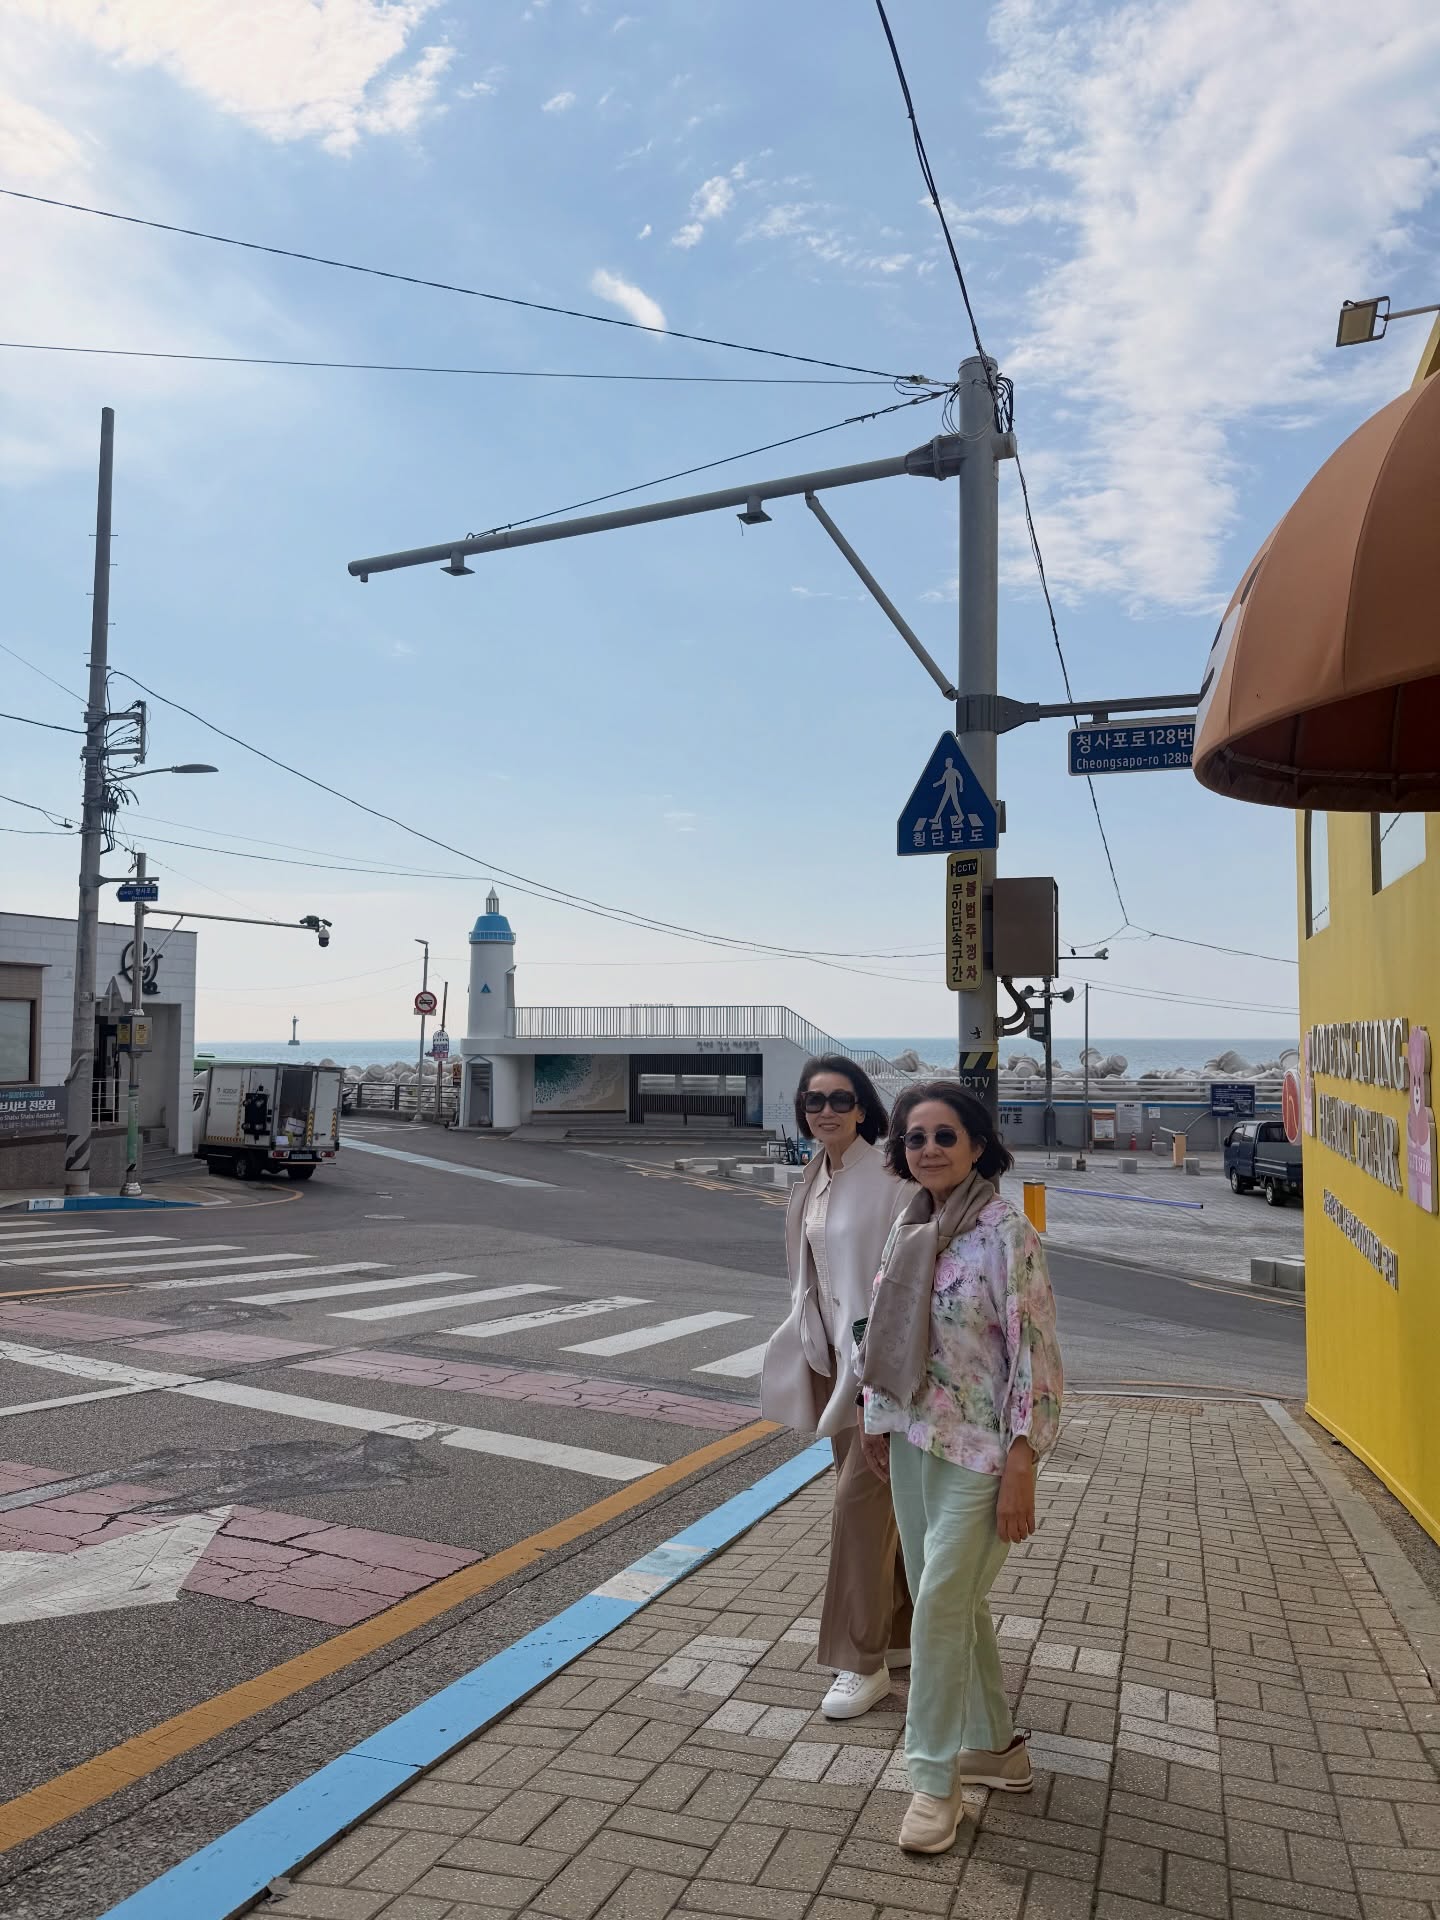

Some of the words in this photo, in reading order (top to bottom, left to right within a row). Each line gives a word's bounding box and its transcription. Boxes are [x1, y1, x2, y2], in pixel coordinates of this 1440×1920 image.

[1076, 755, 1158, 769] Cheongsapo-ro
[912, 829, 984, 847] 횡단보도
[957, 862, 977, 873] CCTV
[951, 884, 963, 983] 무인단속구간
[1350, 1017, 1406, 1091] GIVING
[29, 1099, 55, 1111] 전문점
[1318, 1092, 1354, 1163] HEART
[1356, 1106, 1401, 1192] BEAR
